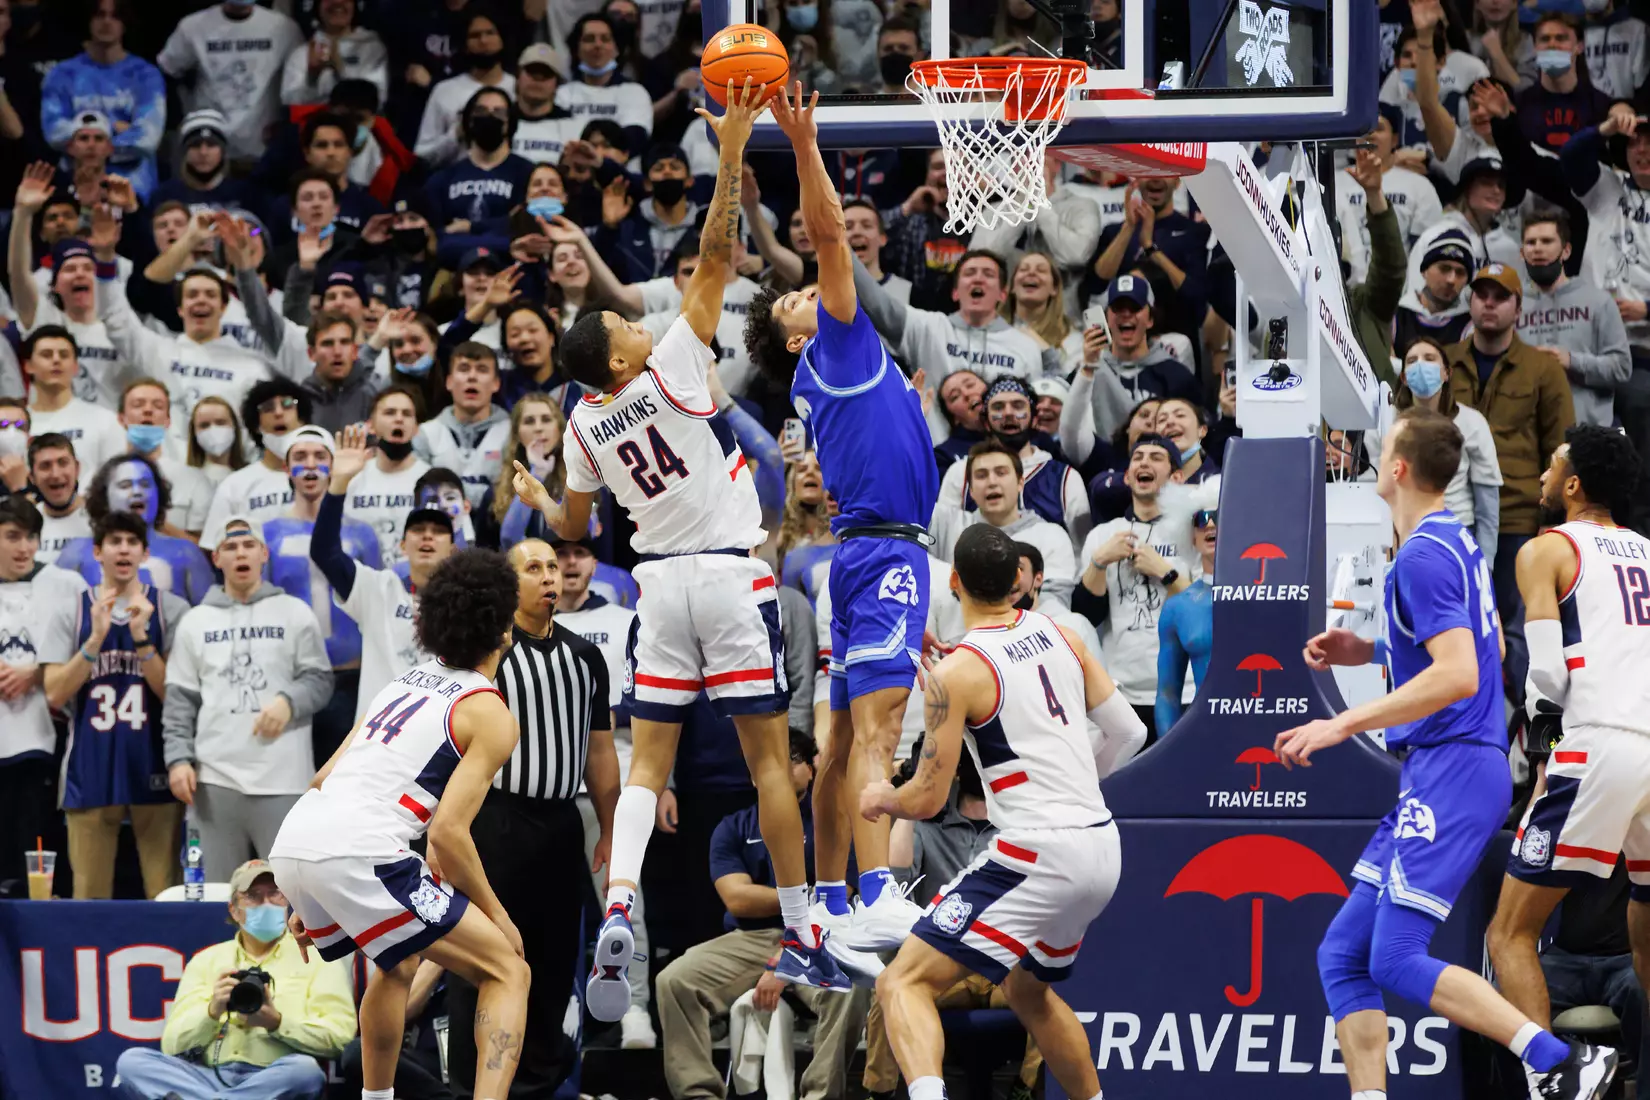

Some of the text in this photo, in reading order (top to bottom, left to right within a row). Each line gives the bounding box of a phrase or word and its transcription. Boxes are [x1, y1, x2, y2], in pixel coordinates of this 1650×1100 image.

[720, 33, 767, 54] ELITE
[449, 179, 513, 200] UCONN
[1516, 306, 1589, 330] UCONN
[973, 351, 1015, 368] XAVIER
[590, 395, 658, 445] HAWKINS
[616, 424, 690, 499] 24
[249, 492, 277, 509] BEAT
[353, 496, 381, 508] BEAT
[1594, 537, 1648, 559] POLLEY
[1211, 585, 1310, 601] TRAVELERS
[1612, 563, 1650, 626] 12
[396, 604, 412, 619] BE
[204, 626, 285, 643] BEAT XAVIER
[1003, 630, 1053, 664] MARTIN
[437, 681, 464, 701] JR.
[1037, 664, 1069, 726] 4
[89, 684, 148, 731] 34
[365, 692, 430, 745] 44
[1206, 791, 1307, 808] TRAVELERS
